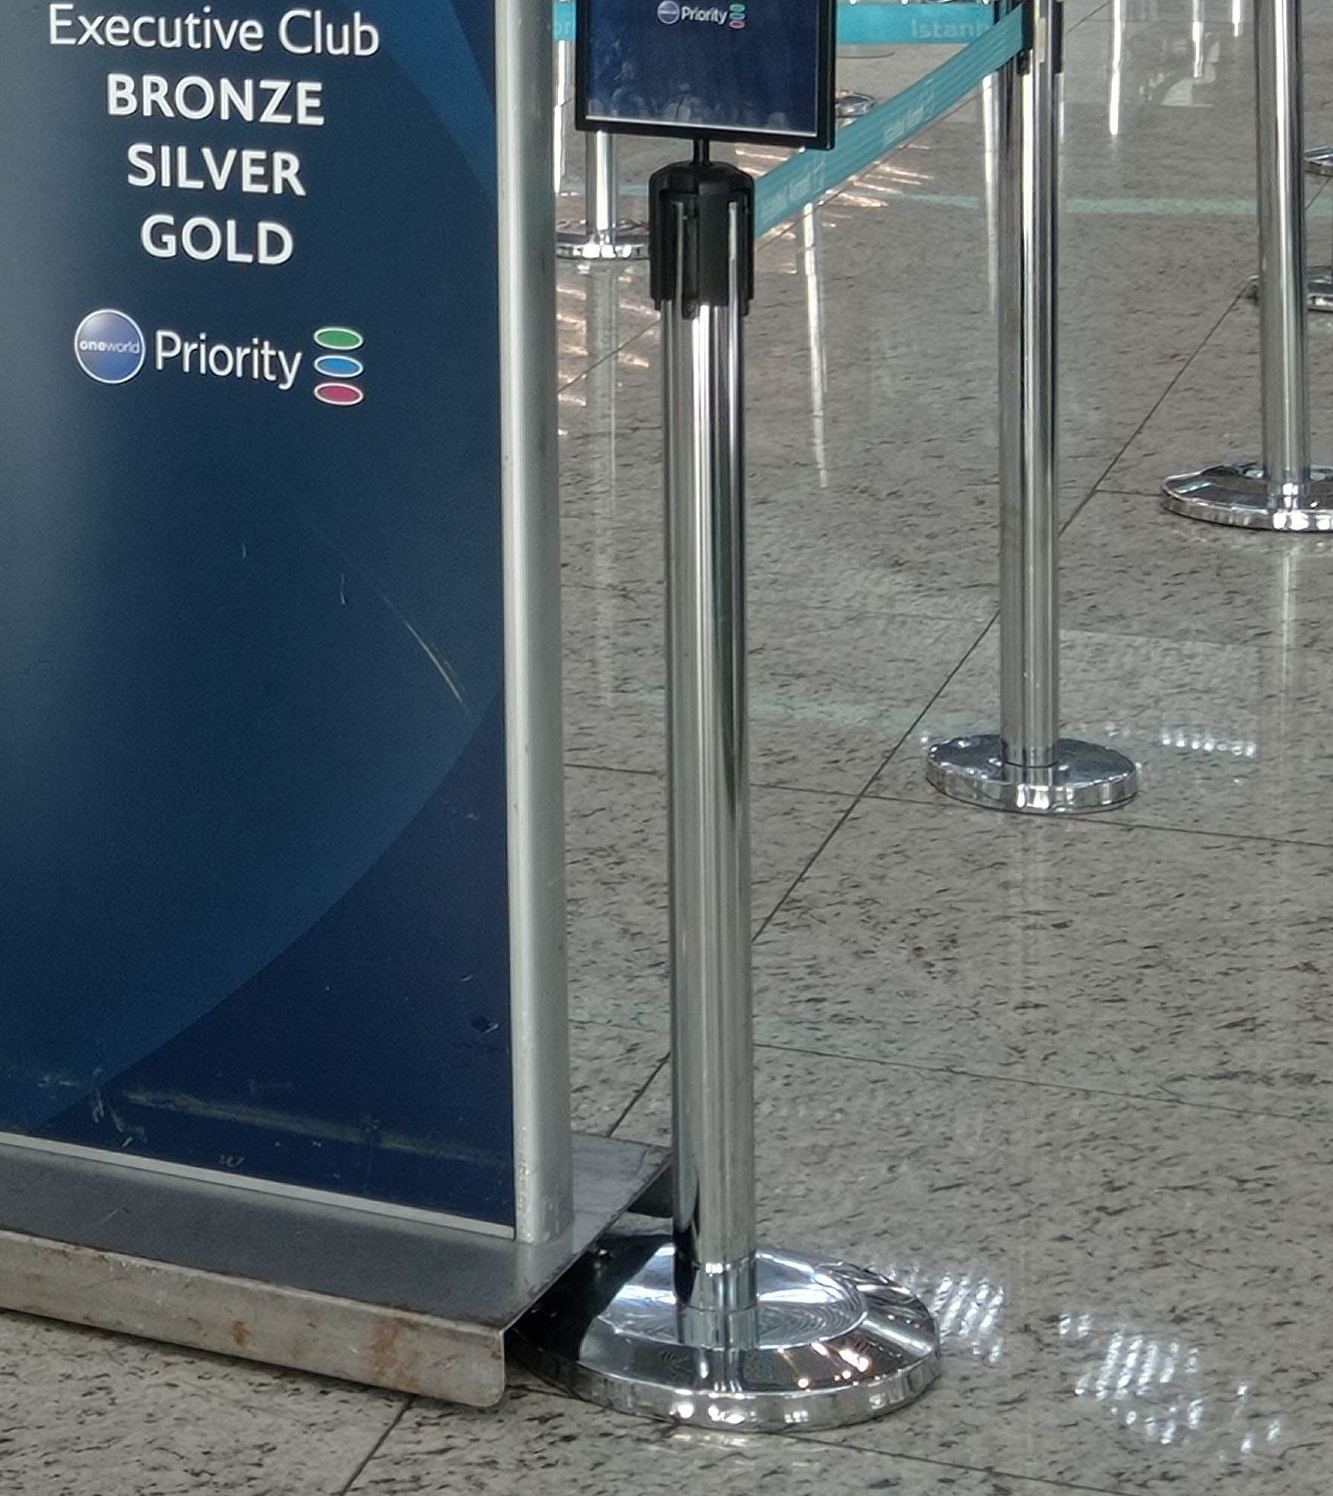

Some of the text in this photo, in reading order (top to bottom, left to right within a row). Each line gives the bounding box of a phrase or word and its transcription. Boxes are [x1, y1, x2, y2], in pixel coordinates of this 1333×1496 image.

[48, 2, 380, 57] Executive Club
[681, 6, 728, 25] Priority
[106, 72, 325, 126] BRONZE
[127, 143, 306, 196] SILVER
[140, 214, 294, 265] GOLD
[79, 329, 303, 391] oneworld Priority
